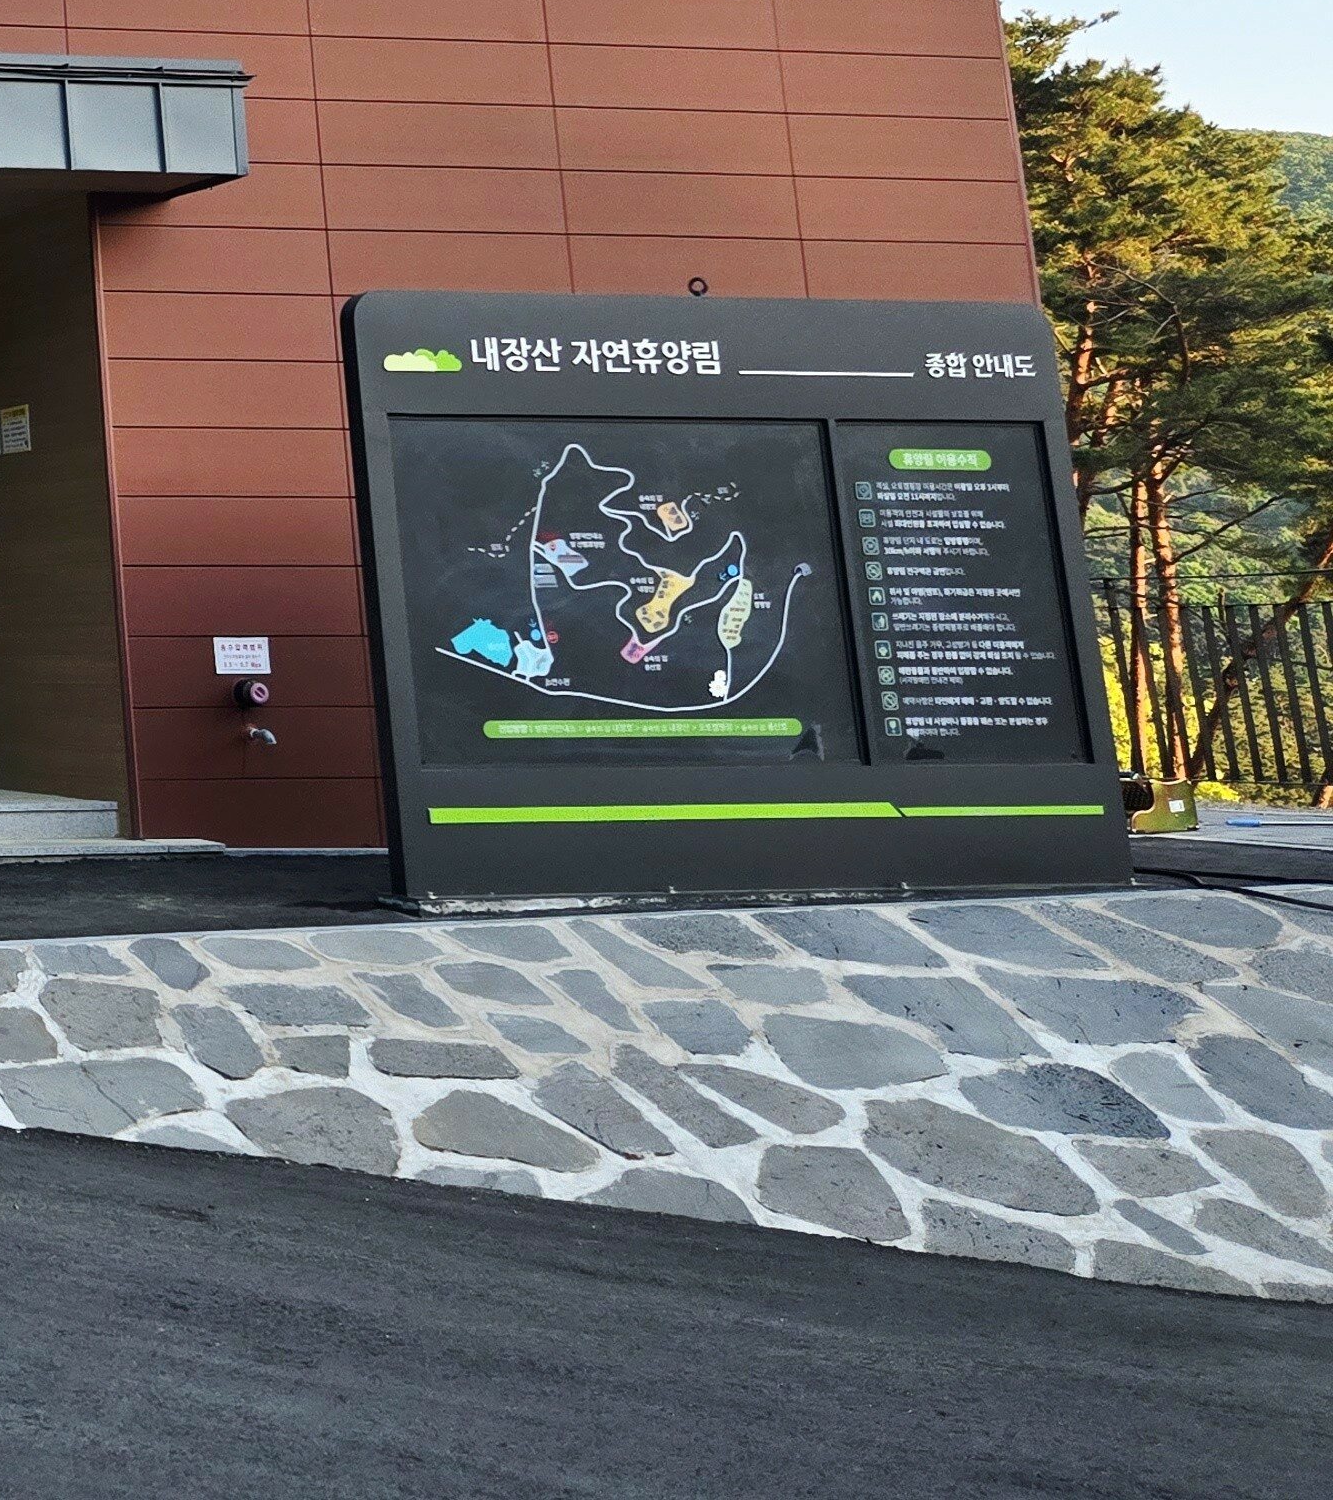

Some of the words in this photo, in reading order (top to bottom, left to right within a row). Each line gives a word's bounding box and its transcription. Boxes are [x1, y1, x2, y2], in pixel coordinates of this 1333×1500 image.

[470, 337, 562, 372] 내장산
[570, 338, 721, 375] 자연휴양림
[925, 352, 967, 378] 종합
[972, 353, 1037, 379] 안내도
